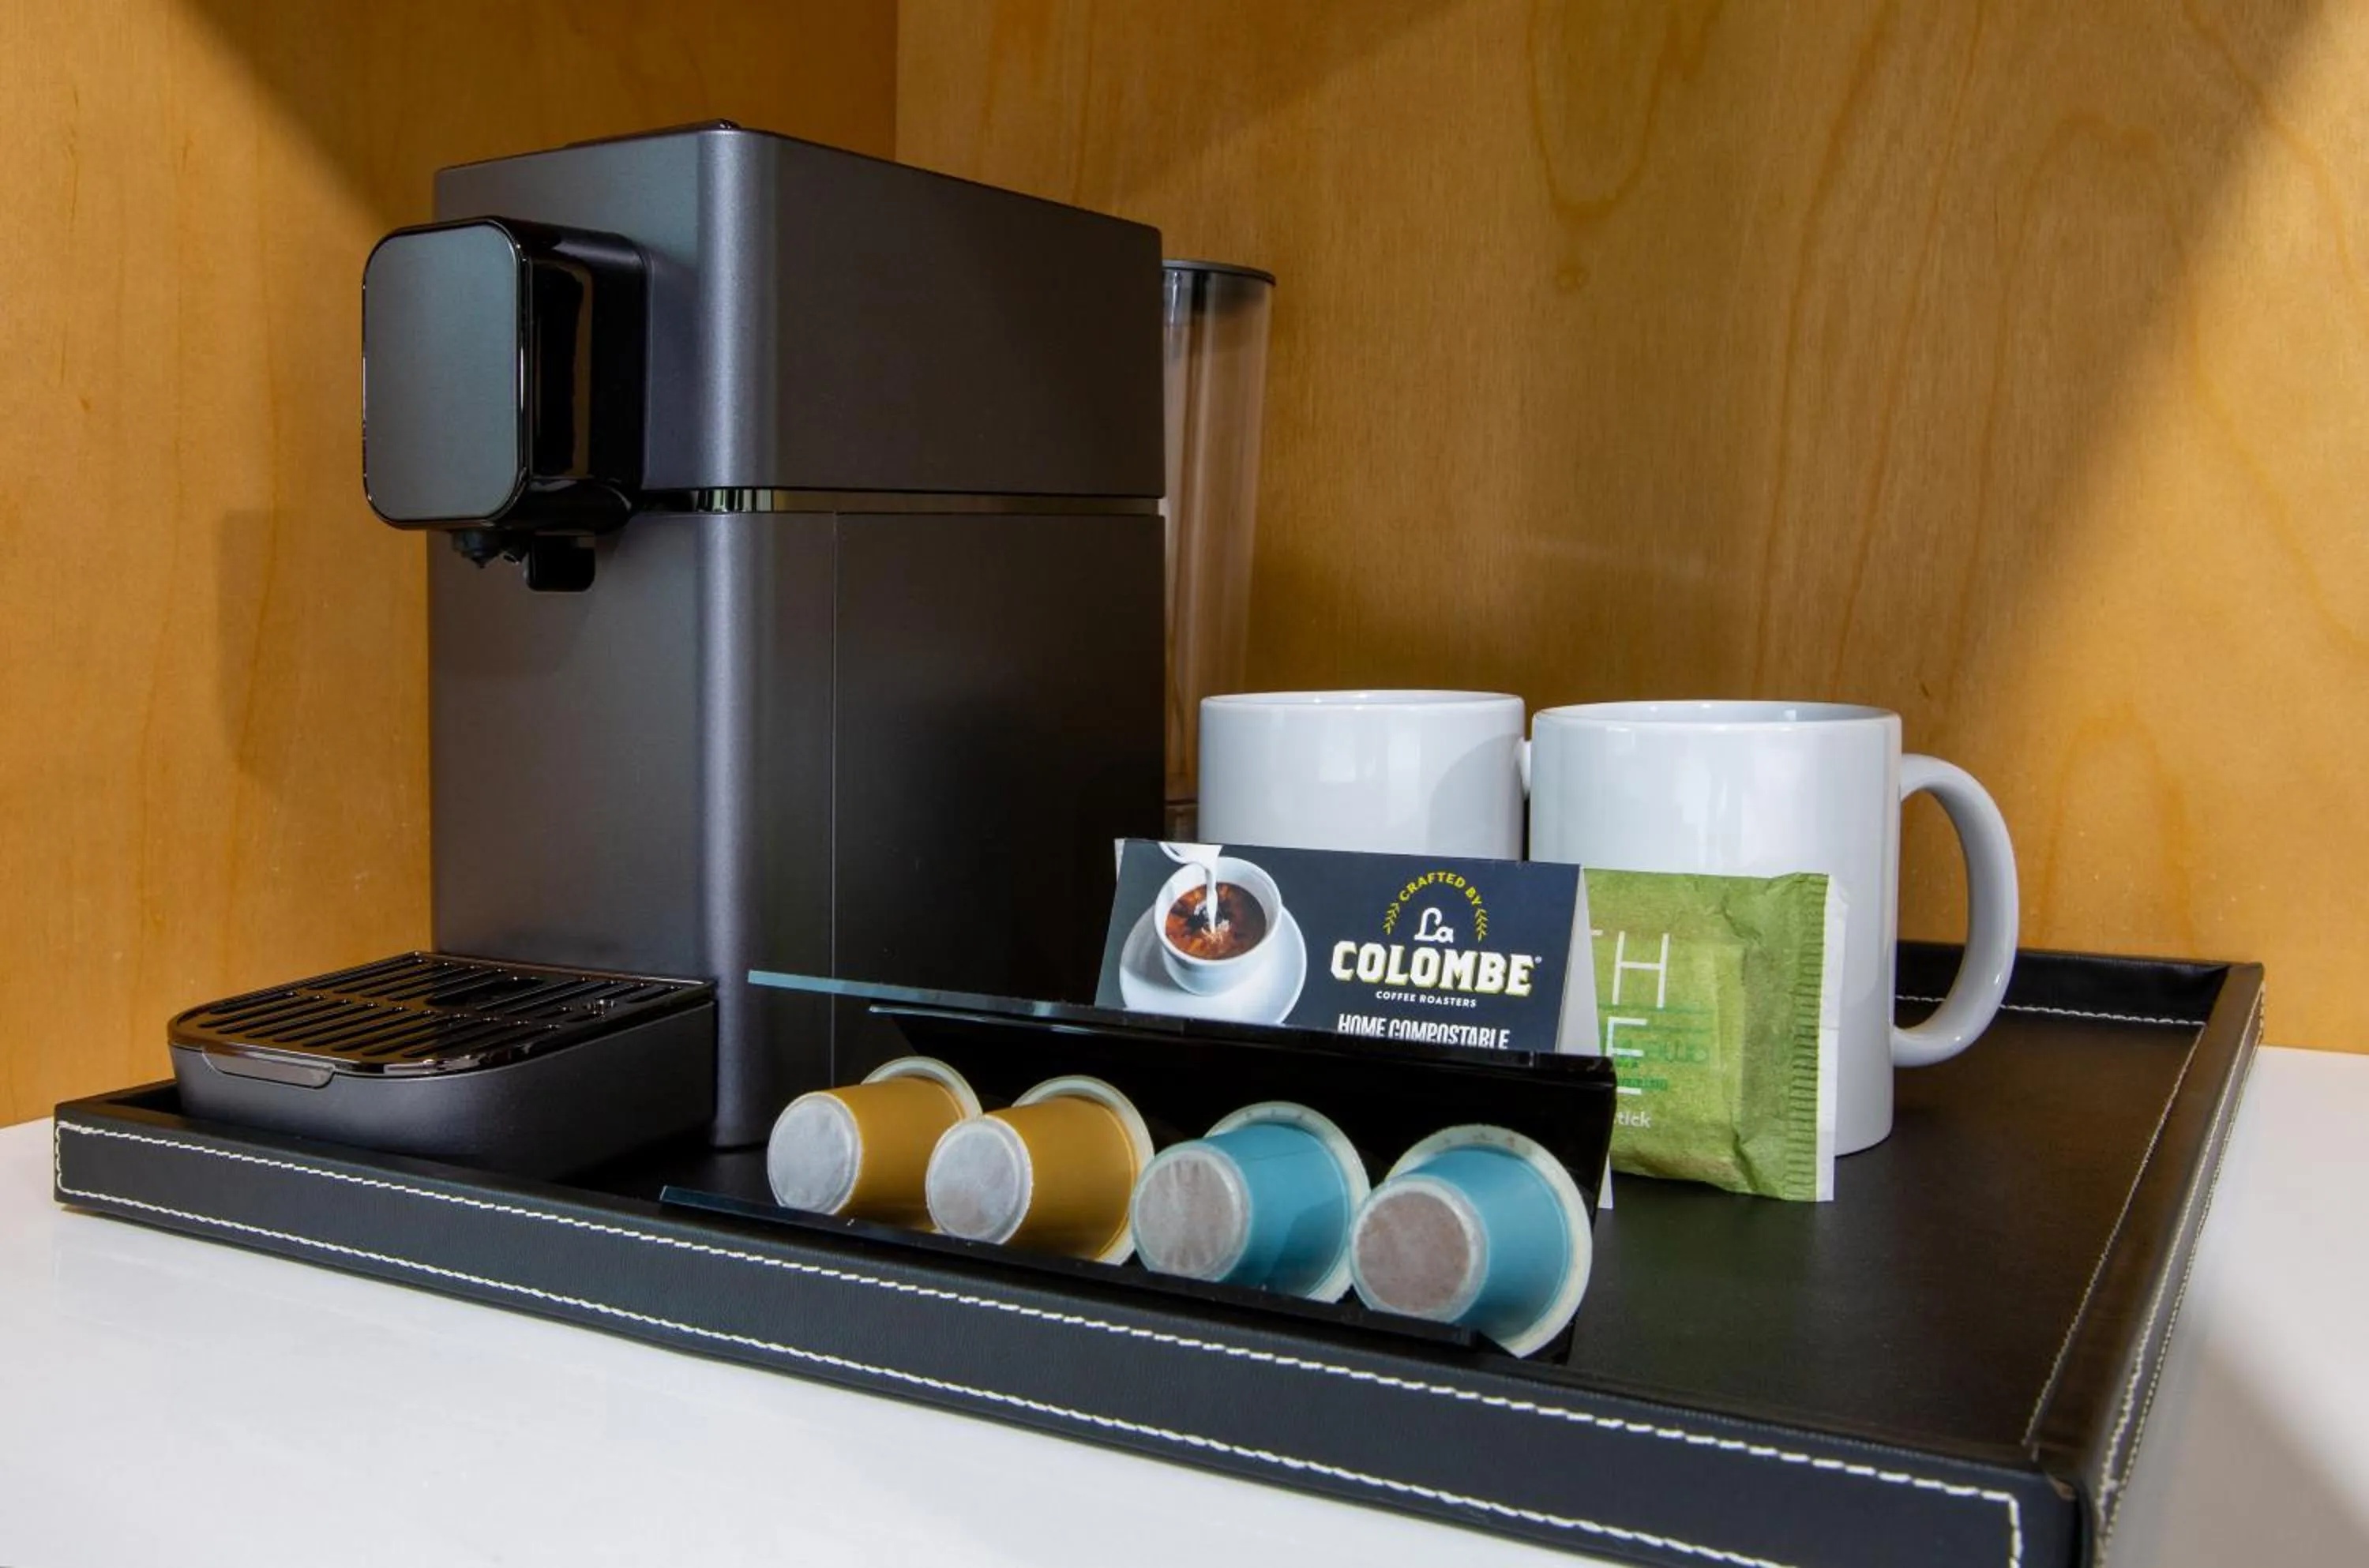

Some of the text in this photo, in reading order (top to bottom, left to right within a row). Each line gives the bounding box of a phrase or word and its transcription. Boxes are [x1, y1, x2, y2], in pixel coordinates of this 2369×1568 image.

[1399, 872, 1482, 906] CRAFTED BY
[1414, 907, 1454, 943] La
[1331, 941, 1534, 997] COLOMBE
[1376, 991, 1477, 1008] COFFEE ROASTERS
[1337, 1013, 1510, 1049] HOME COMPOSTABLE
[1614, 1111, 1652, 1128] tick
